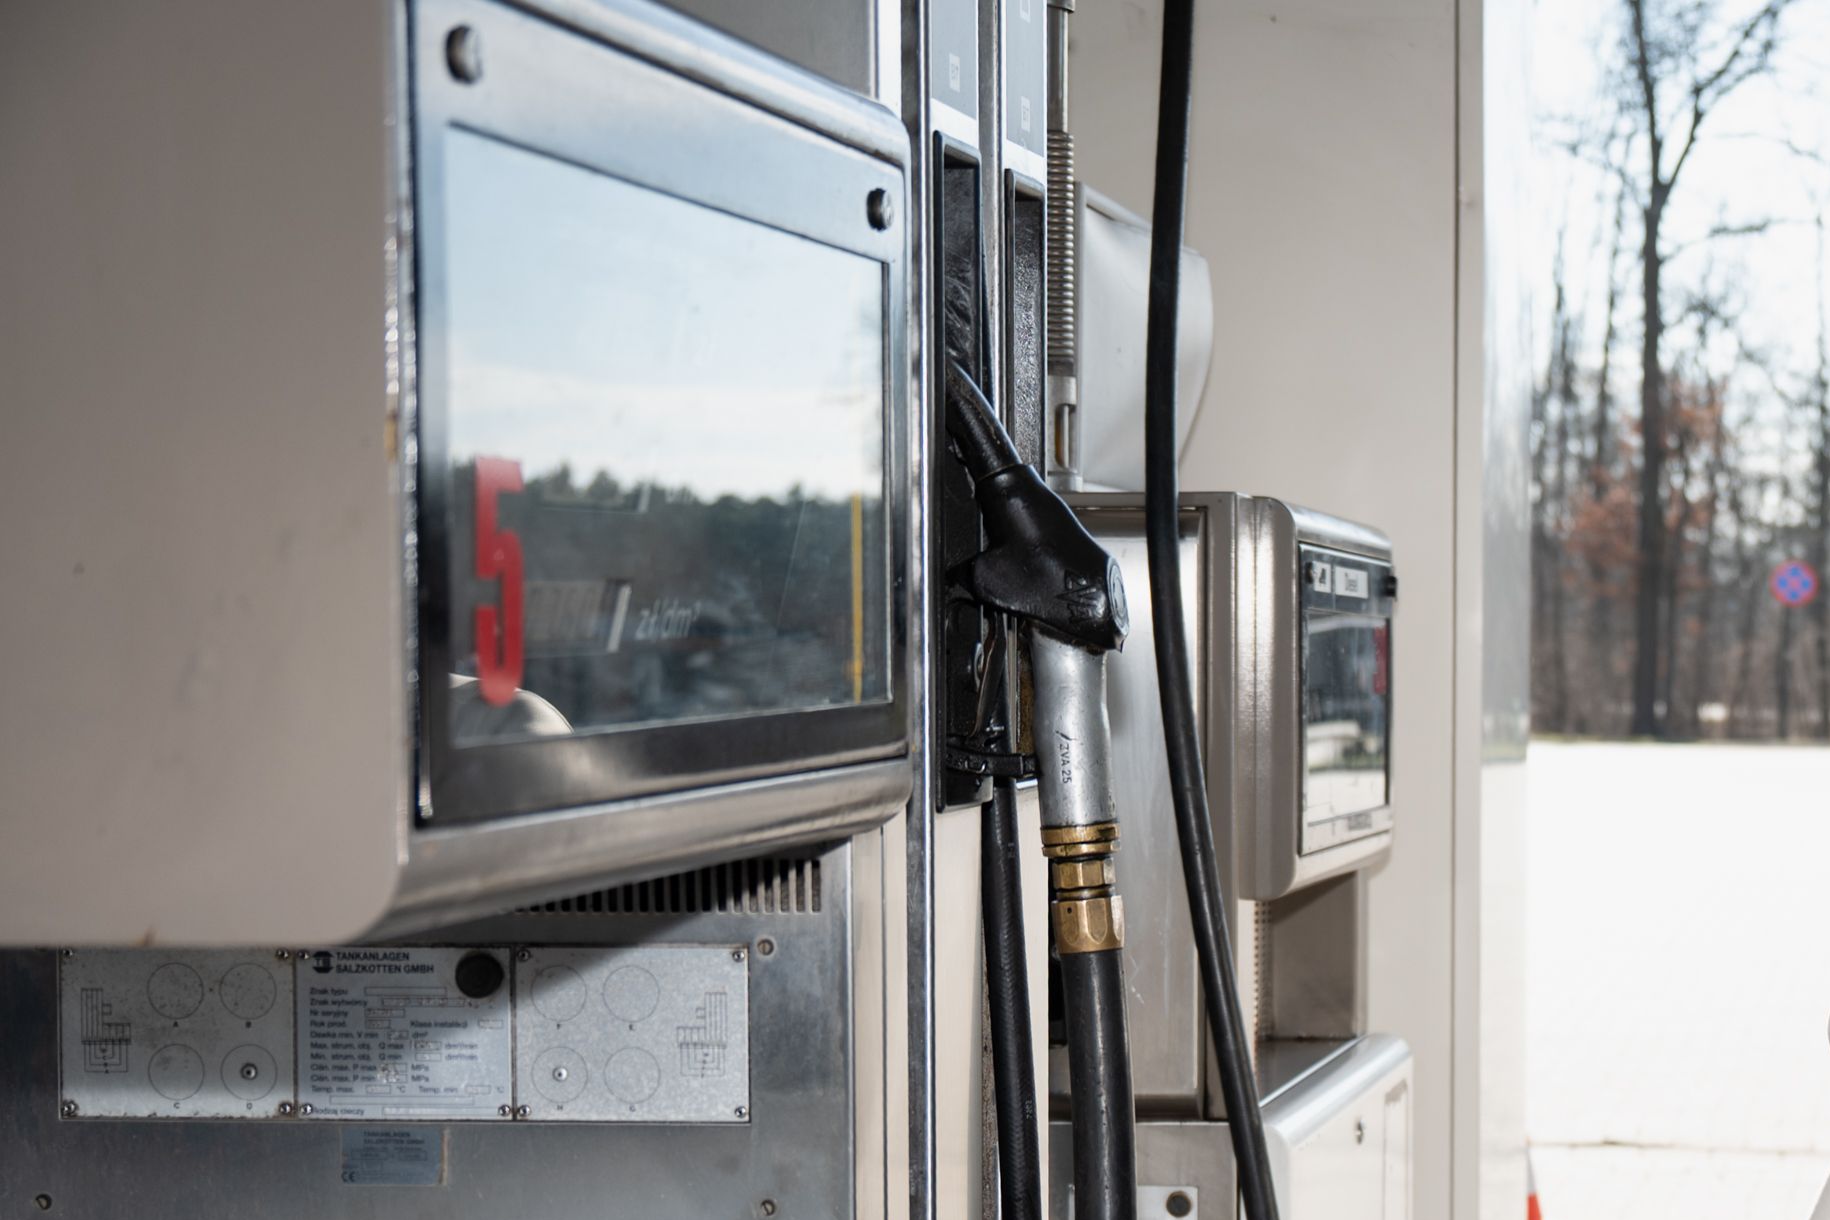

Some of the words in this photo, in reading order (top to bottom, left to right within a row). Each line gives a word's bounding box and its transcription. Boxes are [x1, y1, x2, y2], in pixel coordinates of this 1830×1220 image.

[475, 456, 524, 706] 5
[1059, 743, 1071, 766] ZVA
[1061, 770, 1073, 784] 25
[336, 951, 410, 961] TANKANLAGEN
[336, 964, 402, 974] SALZKOTTEN
[404, 964, 434, 974] GMBH
